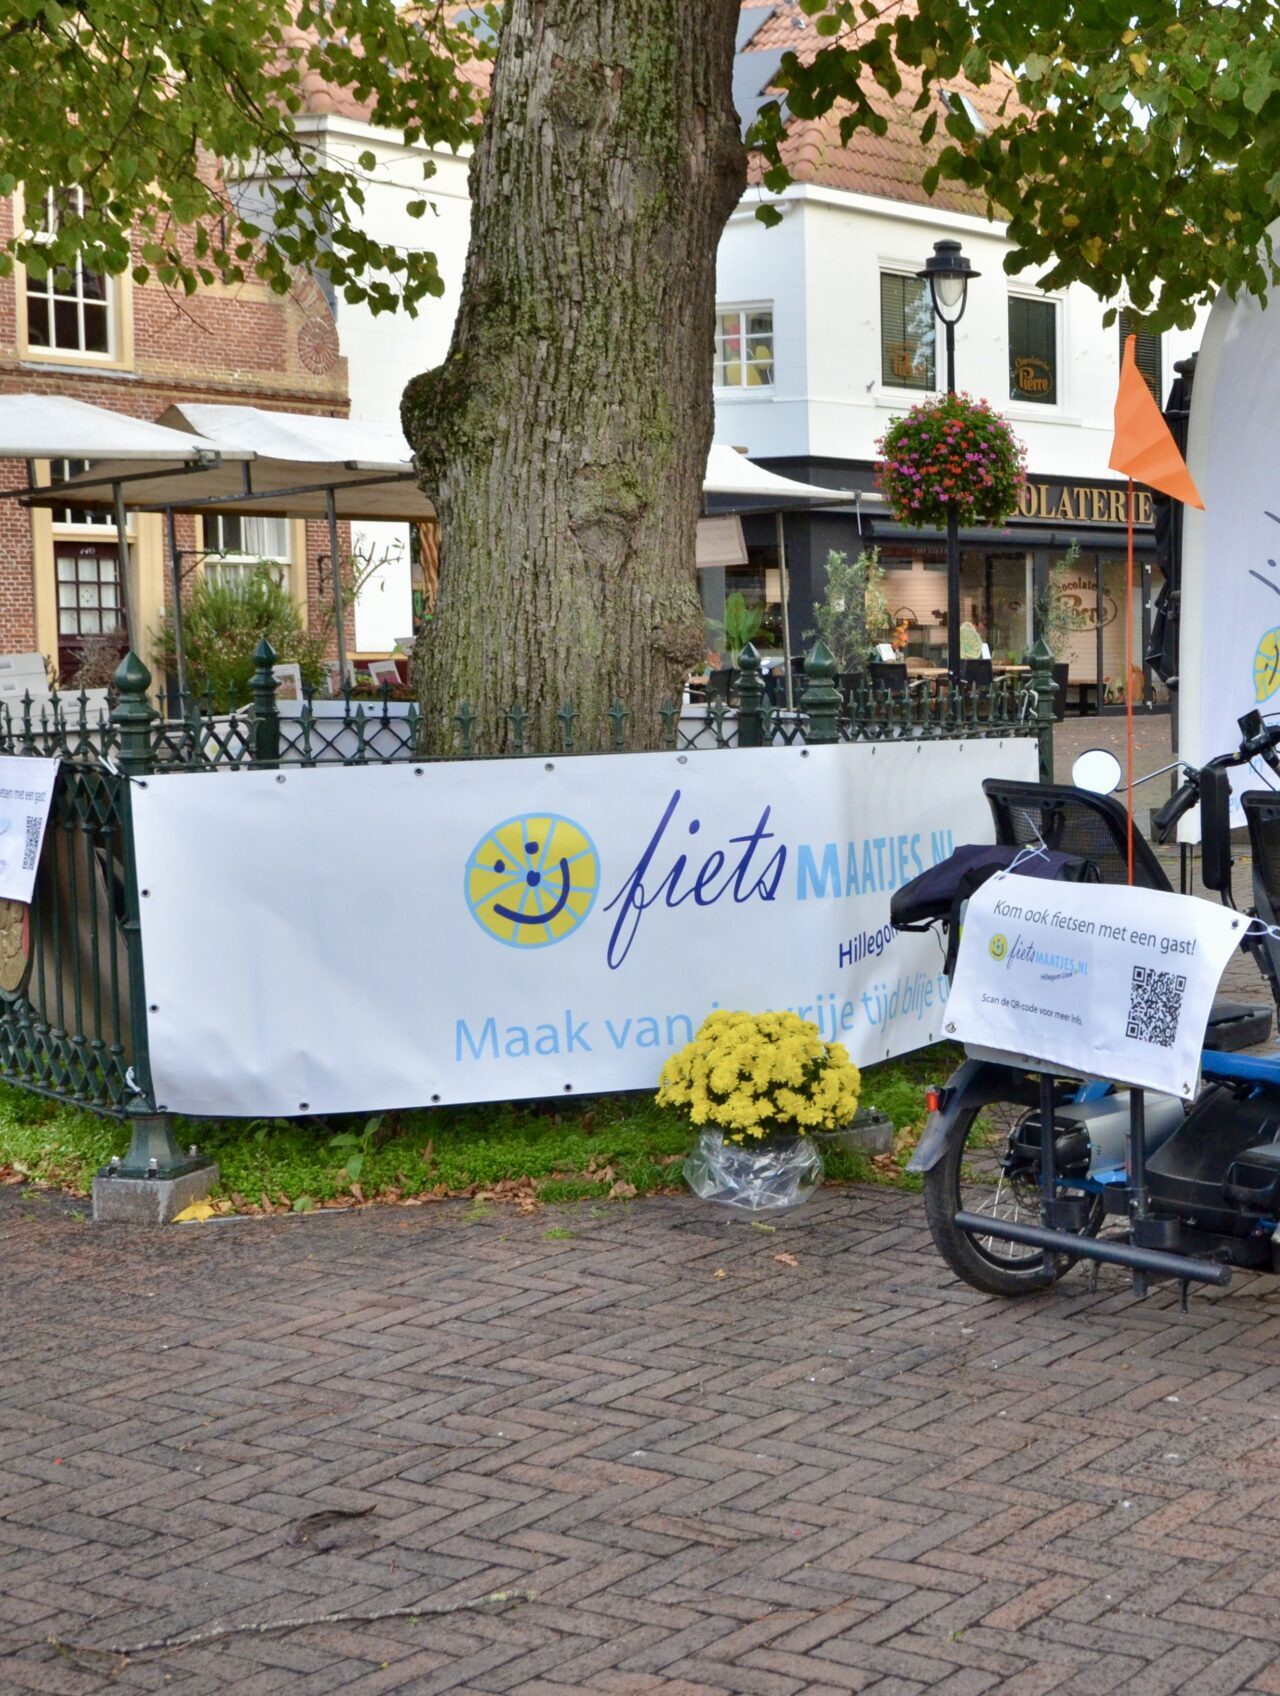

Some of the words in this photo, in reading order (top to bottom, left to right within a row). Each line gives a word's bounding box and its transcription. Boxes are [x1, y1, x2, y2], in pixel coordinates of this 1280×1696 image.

[1008, 483, 1154, 524] OLATERIE
[839, 921, 899, 968] Hillego
[994, 900, 1022, 920] Kom
[1025, 908, 1048, 925] ook
[1050, 911, 1095, 935] fietsen
[1099, 924, 1127, 942] met
[1130, 931, 1157, 948] een
[1160, 938, 1197, 956] gast!
[455, 1009, 592, 1061] Maak
[604, 1014, 693, 1049] van
[766, 993, 854, 1043] rije
[862, 978, 901, 1034] tijd
[902, 972, 932, 1020] blije
[982, 993, 999, 1005] Scan
[1001, 997, 1009, 1007] de
[1010, 999, 1038, 1013] QR-code
[1039, 1007, 1054, 1017] voor
[1054, 1011, 1071, 1022] meer
